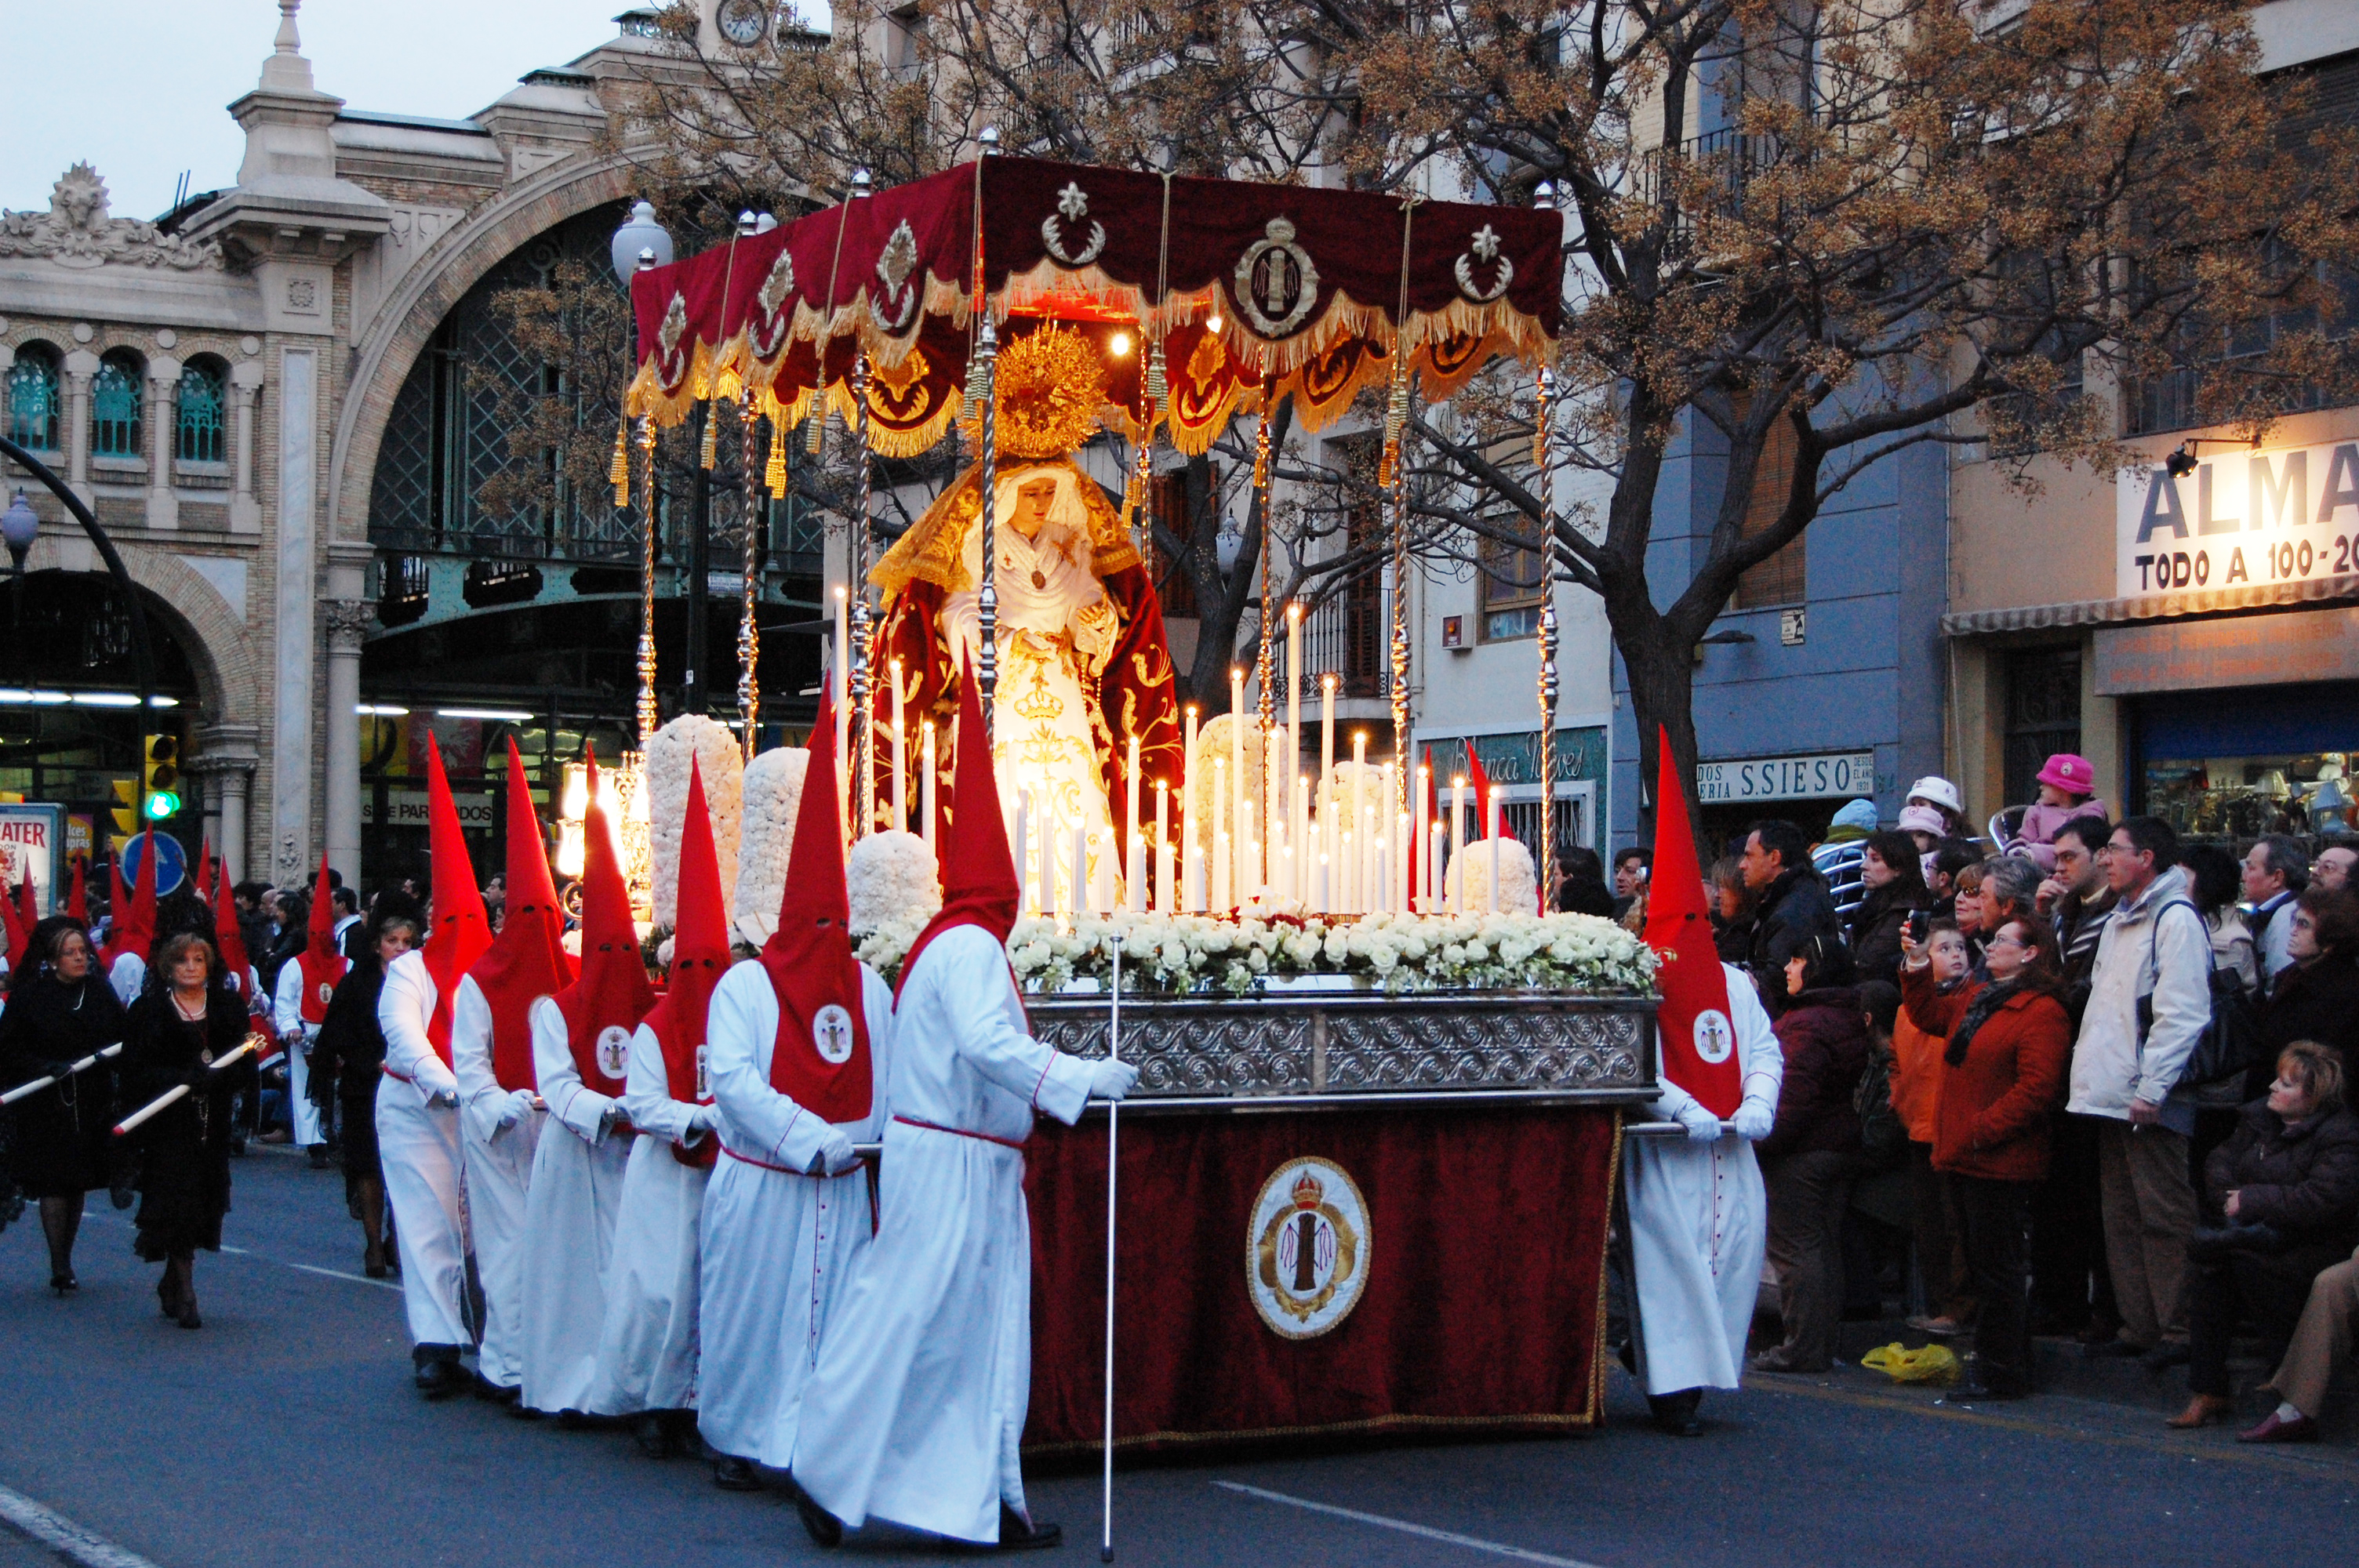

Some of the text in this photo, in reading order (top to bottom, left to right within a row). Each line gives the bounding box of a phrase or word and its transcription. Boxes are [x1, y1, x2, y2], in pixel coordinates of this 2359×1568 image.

[2135, 550, 2209, 590] TODO
[2226, 546, 2248, 583] A
[1526, 732, 1584, 779] Nves
[1853, 756, 1873, 767] DESDE
[1853, 769, 1860, 779] EL
[0, 822, 45, 848] ATER
